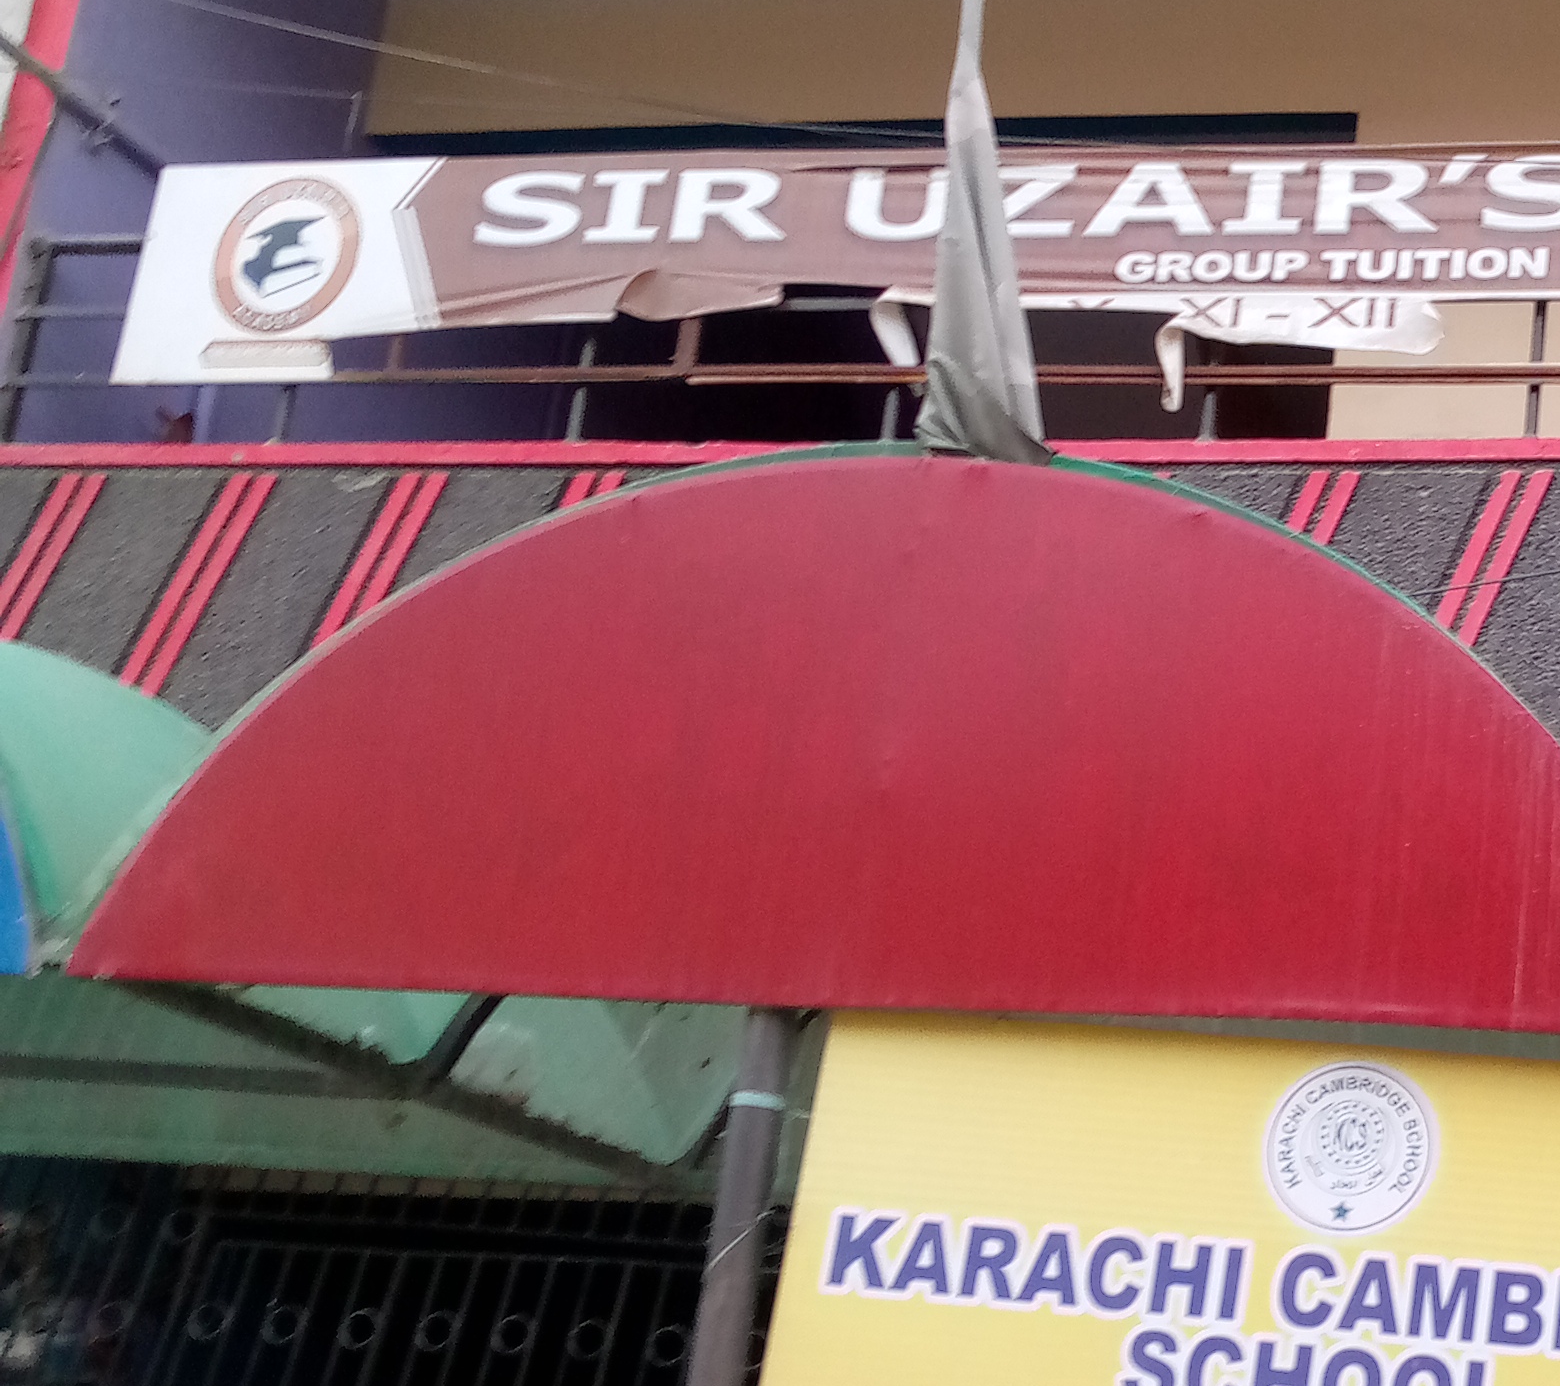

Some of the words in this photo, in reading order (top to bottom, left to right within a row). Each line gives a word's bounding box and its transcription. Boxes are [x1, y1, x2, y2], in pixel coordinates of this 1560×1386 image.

[474, 168, 786, 248] SIR
[1114, 249, 1310, 284] GROUP
[1321, 246, 1549, 283] TUITION
[1307, 296, 1399, 330] XII
[1305, 1075, 1411, 1118] CAMBRIDGE
[826, 1214, 1248, 1322] KARACHI
